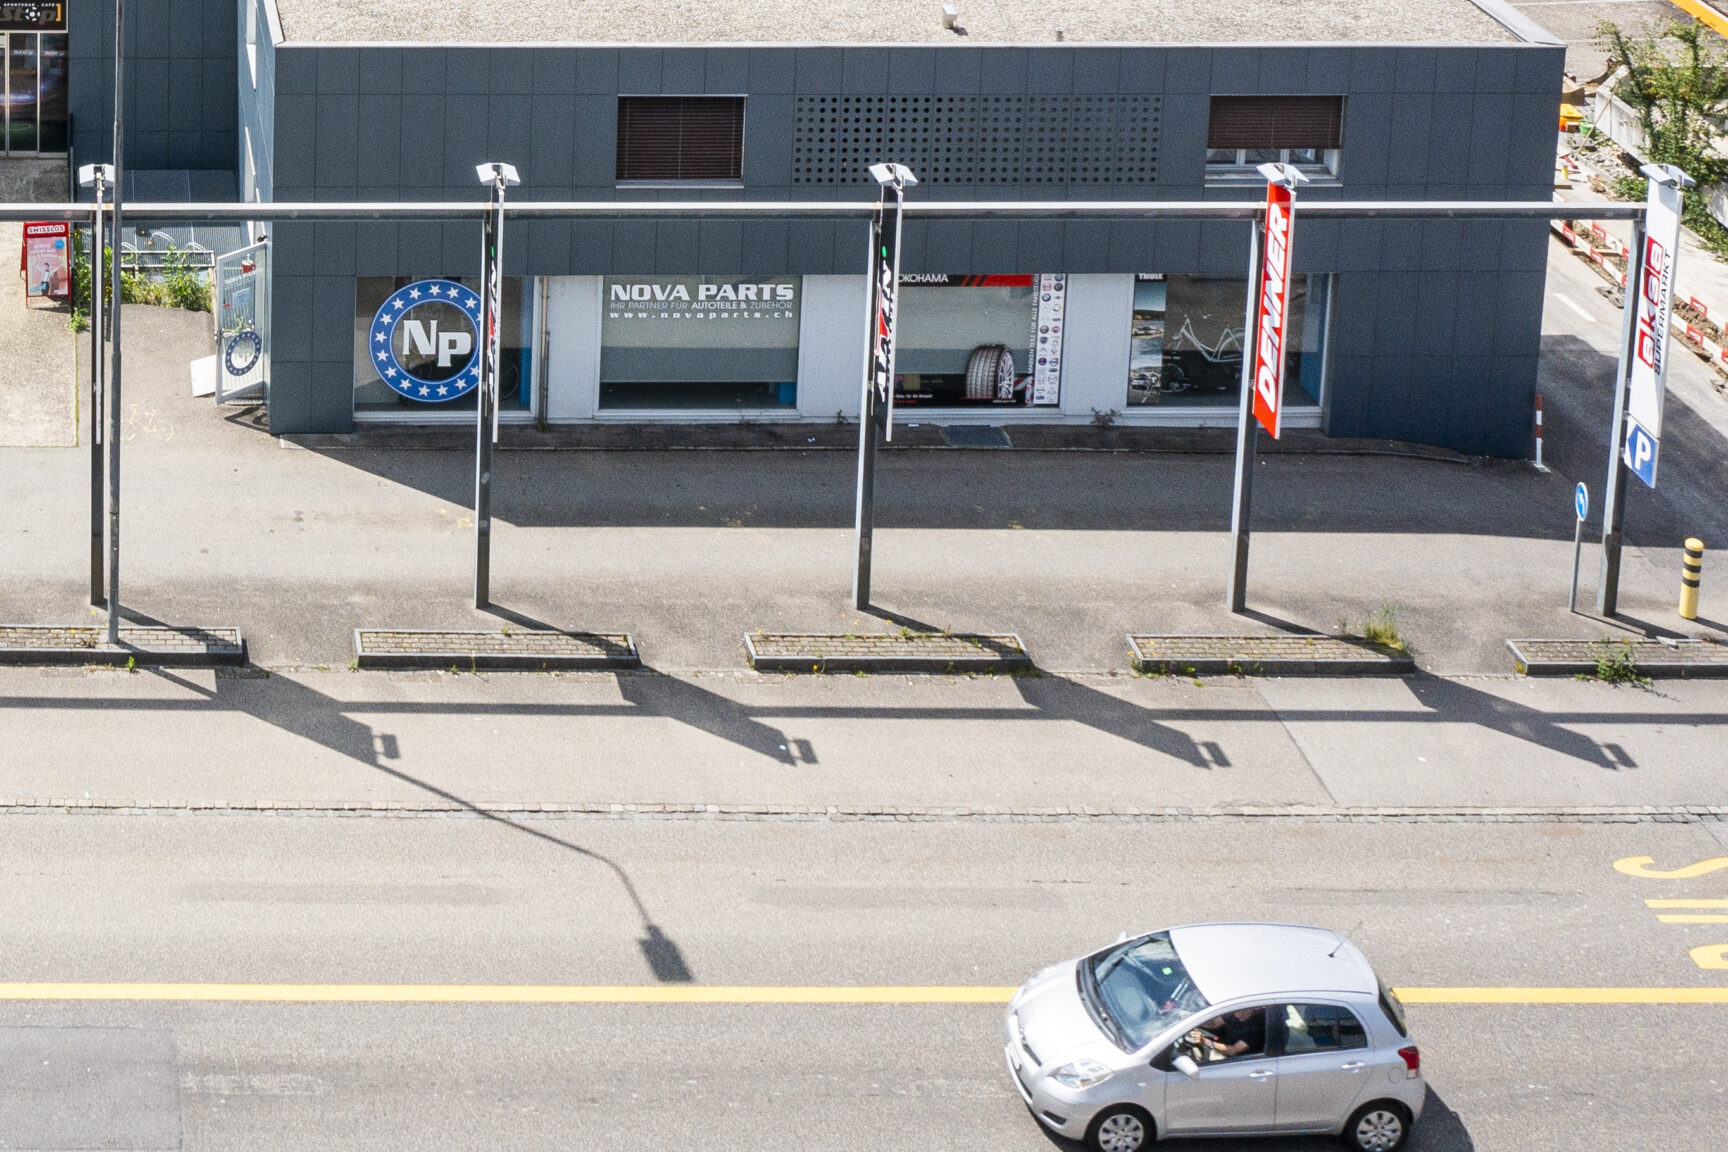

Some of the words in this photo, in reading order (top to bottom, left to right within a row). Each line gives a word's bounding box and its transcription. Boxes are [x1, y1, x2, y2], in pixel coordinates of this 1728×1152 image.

[28, 225, 64, 233] SWISSLOS
[898, 274, 949, 283] OKOHAMA
[610, 284, 692, 301] NOVA
[698, 284, 794, 301] PARTS
[610, 301, 626, 309] IHR
[628, 301, 668, 309] PARTNER
[671, 301, 688, 309] FÜR
[691, 301, 738, 309] AUTOTEILE
[739, 301, 747, 309] &
[750, 300, 793, 309] ZUBEHÖR
[1258, 203, 1288, 413] DENNER
[610, 311, 793, 319] www.novaparts.ch
[1653, 248, 1670, 375] SUPERMARKT
[1633, 432, 1652, 470] P
